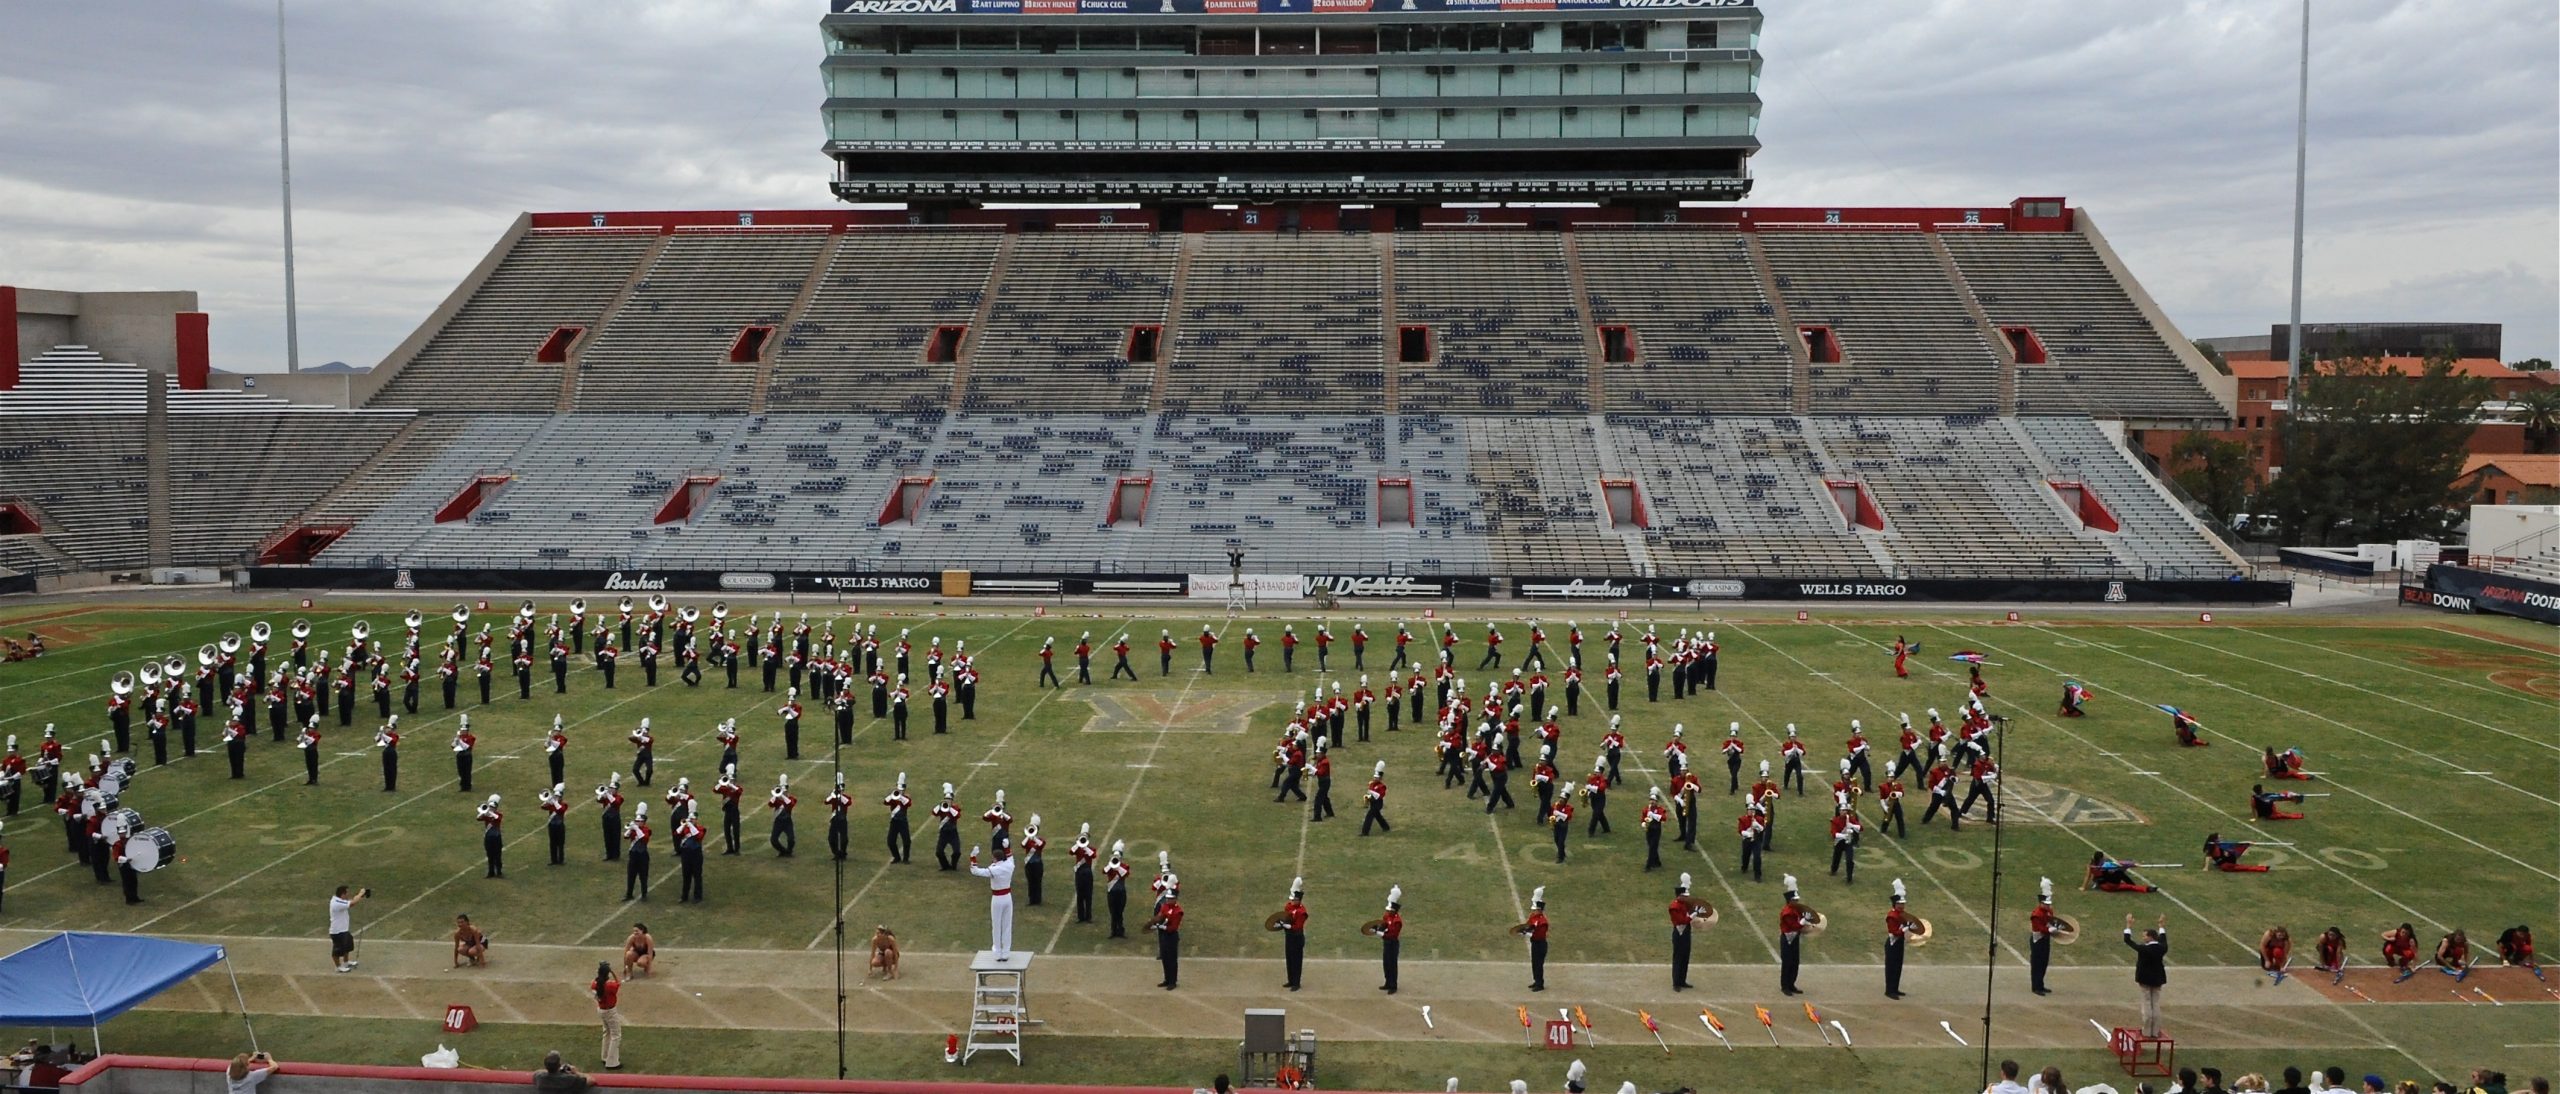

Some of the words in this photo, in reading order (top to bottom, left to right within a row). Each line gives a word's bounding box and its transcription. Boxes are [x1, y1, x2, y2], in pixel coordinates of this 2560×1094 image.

[843, 0, 957, 13] ARIZONA
[972, 0, 980, 8] 22
[980, 0, 992, 8] ART
[993, 0, 1020, 8] LUPPINO
[1032, 0, 1051, 8] RICKY
[1052, 0, 1077, 8] HUNLEY
[1087, 0, 1109, 8] CHUCK
[1110, 0, 1128, 8] CECIL
[1239, 0, 1258, 8] LEWIS
[594, 218, 603, 226] 17
[741, 217, 752, 226] 18
[1100, 216, 1113, 224] 20
[1246, 215, 1257, 224] 21
[1467, 215, 1479, 223] 22
[1664, 214, 1677, 222] 23
[1826, 215, 1839, 223] 24
[1965, 215, 1979, 223] 25
[244, 378, 255, 387] 16
[604, 572, 668, 590] Bashas'
[827, 578, 878, 589] WELLS
[881, 578, 930, 589] FARGO
[1191, 582, 1226, 591] UNIVERSITY
[1268, 582, 1285, 591] BAND
[1286, 582, 1300, 591] DAY
[1800, 584, 1853, 595] WELLS
[1857, 584, 1906, 595] FARGO
[447, 1008, 465, 1029] 40
[1549, 1025, 1568, 1045] 40
